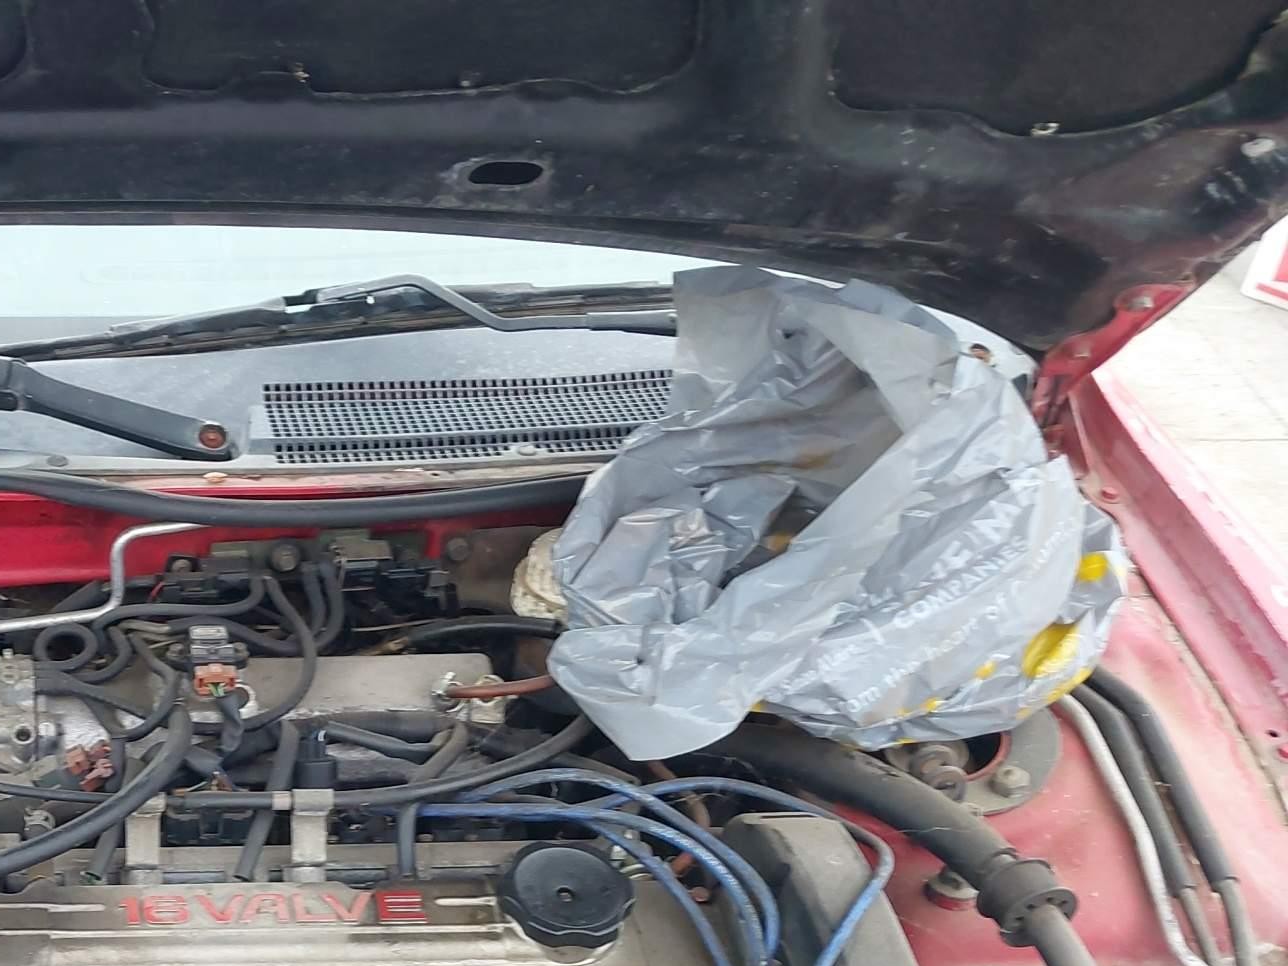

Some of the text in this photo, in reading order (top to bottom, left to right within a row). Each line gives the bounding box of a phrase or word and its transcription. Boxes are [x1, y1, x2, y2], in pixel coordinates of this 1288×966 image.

[892, 535, 1028, 629] COMPANIES
[120, 889, 428, 925] 16 VALVE
